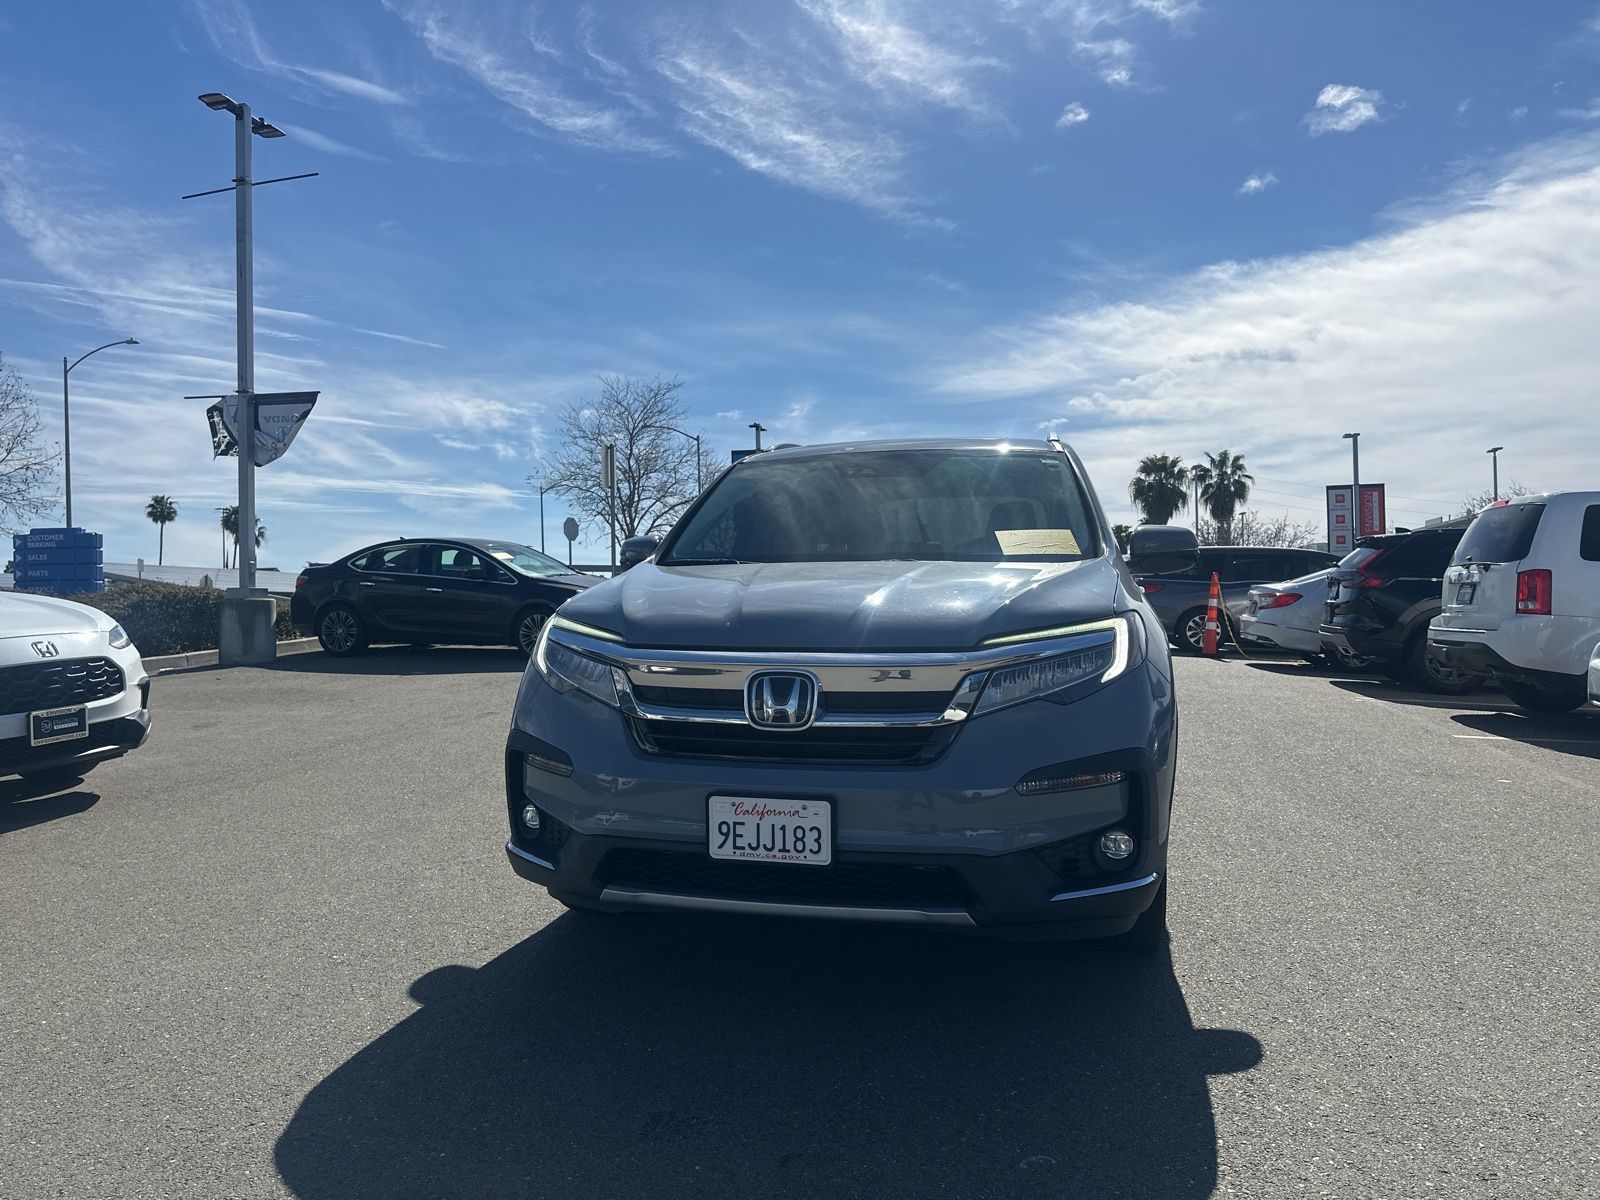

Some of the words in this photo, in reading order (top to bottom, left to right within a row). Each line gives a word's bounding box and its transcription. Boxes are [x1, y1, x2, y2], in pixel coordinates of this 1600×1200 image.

[262, 415, 299, 424] ONDA
[1363, 490, 1373, 532] ENVISION
[734, 802, 808, 821] California
[717, 821, 822, 854] 9EJJ183
[739, 851, 801, 860] dmv.ca.gov
